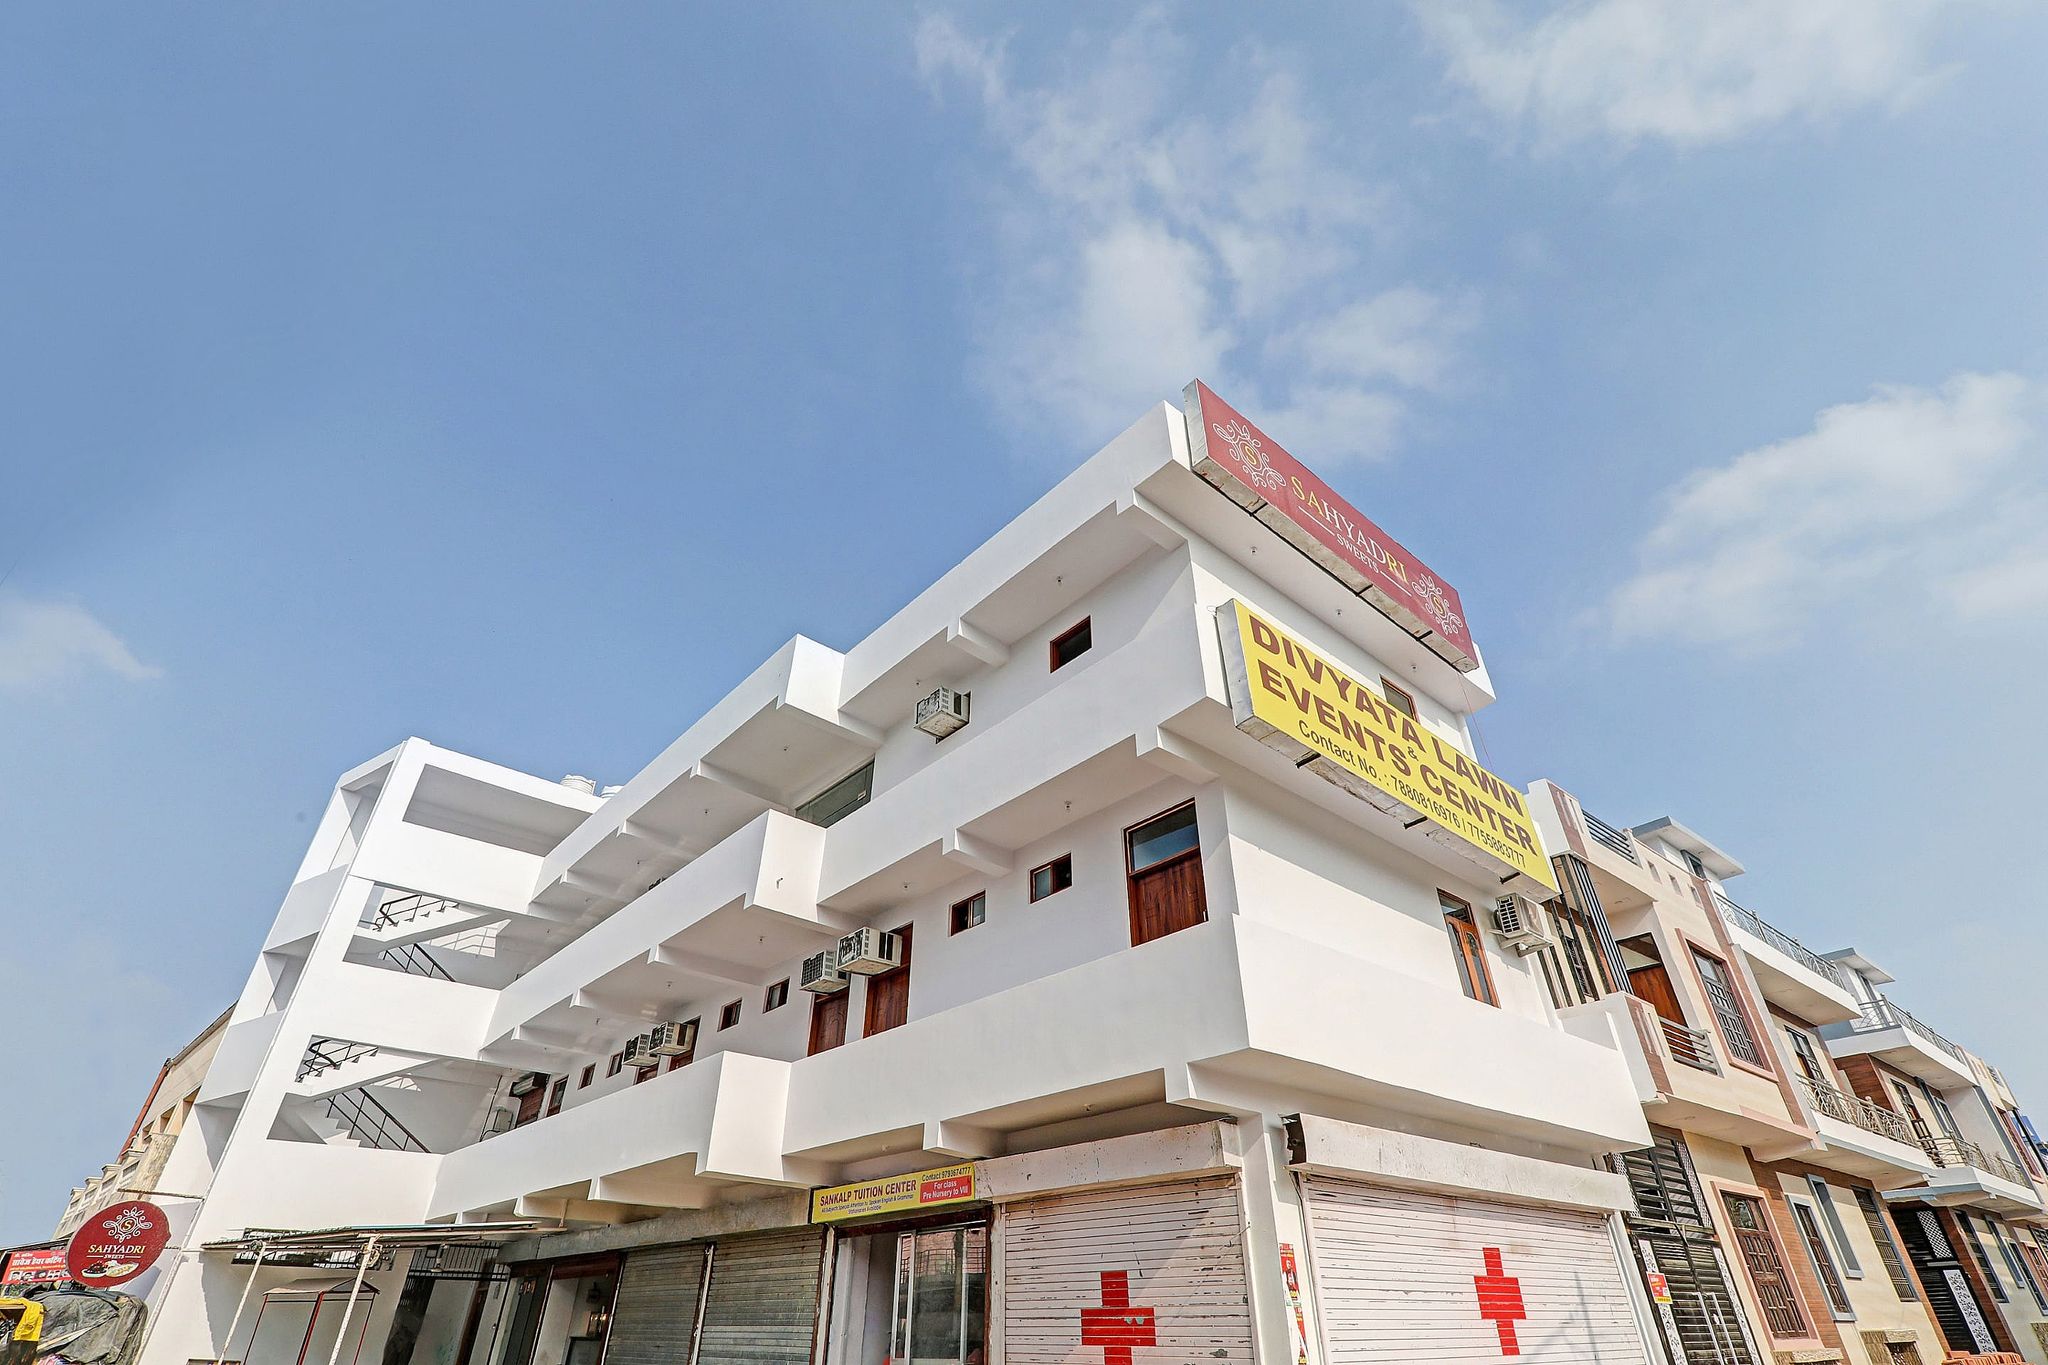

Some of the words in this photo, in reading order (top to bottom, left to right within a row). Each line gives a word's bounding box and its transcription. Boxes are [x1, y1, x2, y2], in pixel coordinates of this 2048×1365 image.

[1290, 476, 1409, 585] SAHYADRI
[1336, 533, 1380, 573] SWEETS
[1249, 614, 1427, 753] DIVYATA
[1430, 732, 1524, 817] LAWN
[1257, 659, 1411, 777] EVENTS
[1419, 764, 1538, 856] CENTER
[1407, 746, 1419, 762] &
[1298, 719, 1355, 766] Contact
[1391, 774, 1461, 828] 7880816976
[1467, 823, 1526, 868] 7755883777
[820, 1191, 852, 1206] SANKALP
[854, 1185, 883, 1200] TUITION
[886, 1179, 917, 1194] CENTER
[922, 1172, 940, 1181] Contact
[943, 1180, 957, 1188] class
[88, 1245, 146, 1253] SAHYADRI
